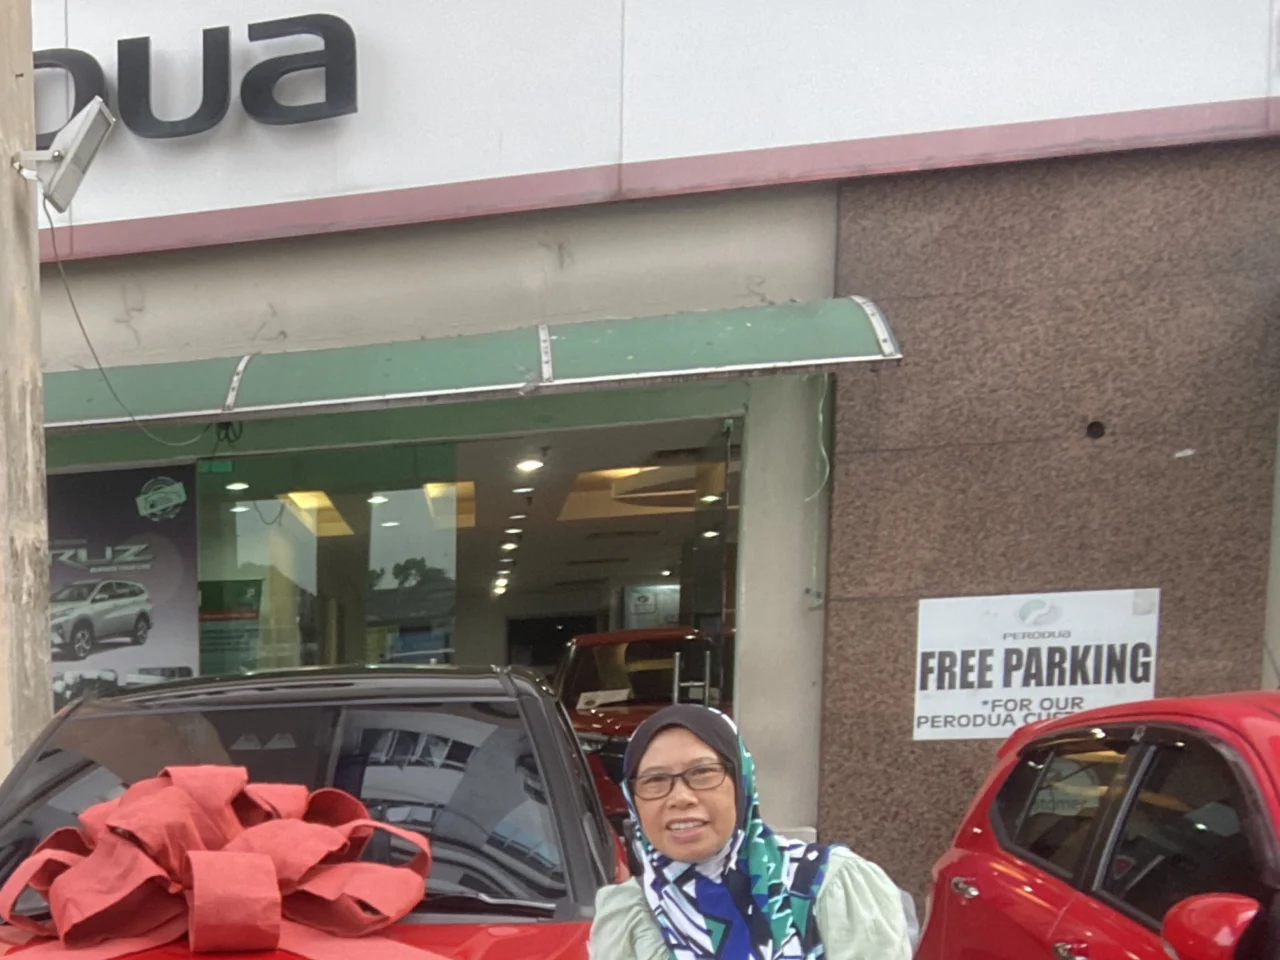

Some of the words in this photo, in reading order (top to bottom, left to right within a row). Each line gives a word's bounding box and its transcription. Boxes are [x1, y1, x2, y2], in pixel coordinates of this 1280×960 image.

[920, 648, 994, 691] FREE
[1002, 642, 1152, 688] PARKING
[1039, 697, 1084, 711] OUR
[917, 713, 1016, 729] PERODUA
